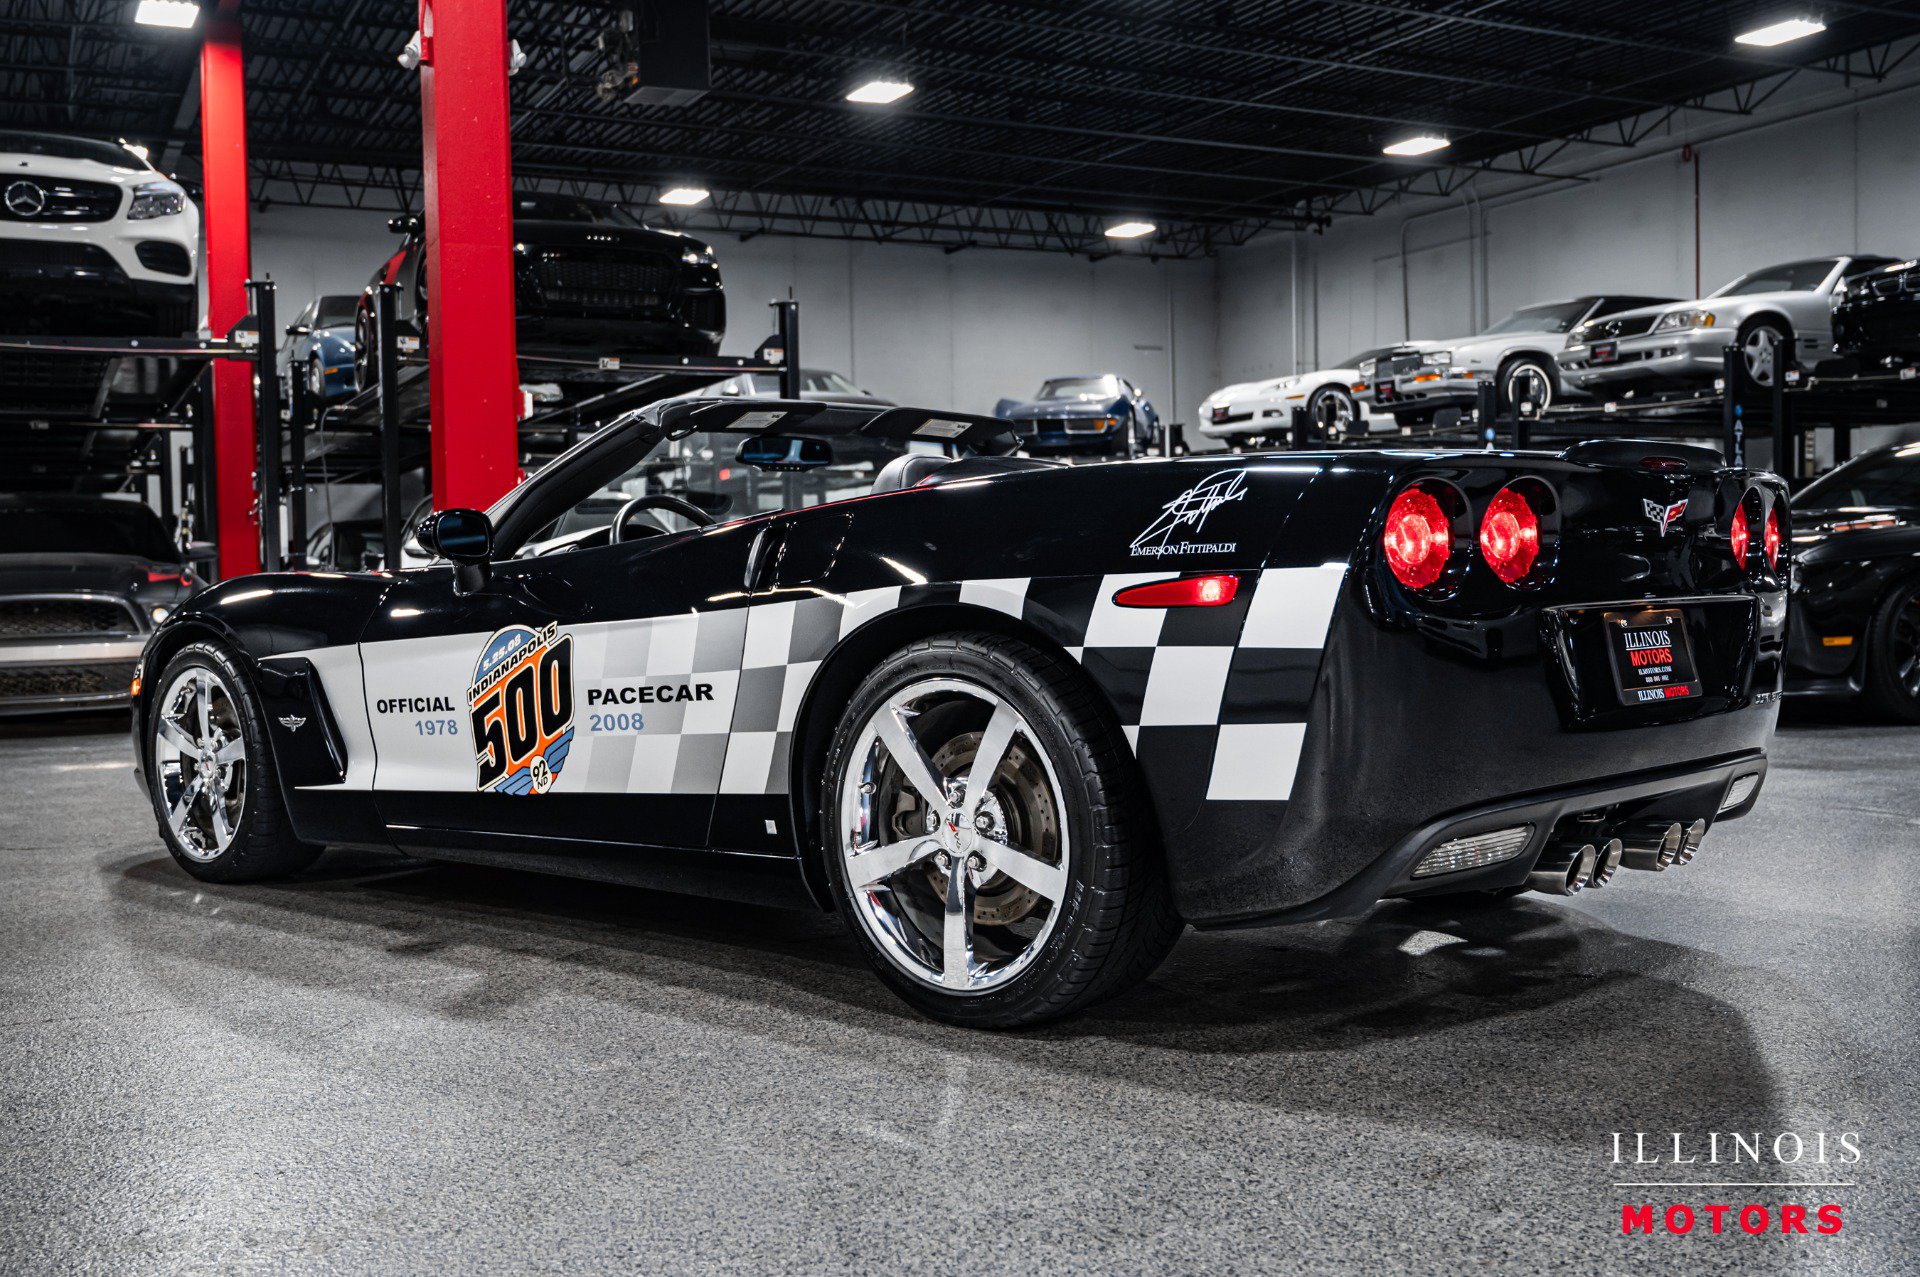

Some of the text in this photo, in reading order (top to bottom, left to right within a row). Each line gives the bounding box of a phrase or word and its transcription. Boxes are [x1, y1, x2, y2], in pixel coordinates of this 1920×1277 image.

[1734, 419, 1743, 468] ATLA
[1624, 630, 1671, 648] ILLINOIS
[483, 633, 522, 671] 5.25.08
[1630, 648, 1673, 666] MOTORS
[468, 624, 556, 701] INDIANAPOLIS
[587, 683, 714, 706] PACECAR
[1637, 685, 1689, 701] ILLINOIS MOTORS
[376, 696, 456, 714] OFFICIAL
[471, 637, 574, 789] 500
[415, 719, 458, 736] 1978
[589, 712, 645, 732] 2008
[532, 760, 548, 782] 92
[537, 776, 548, 790] ND
